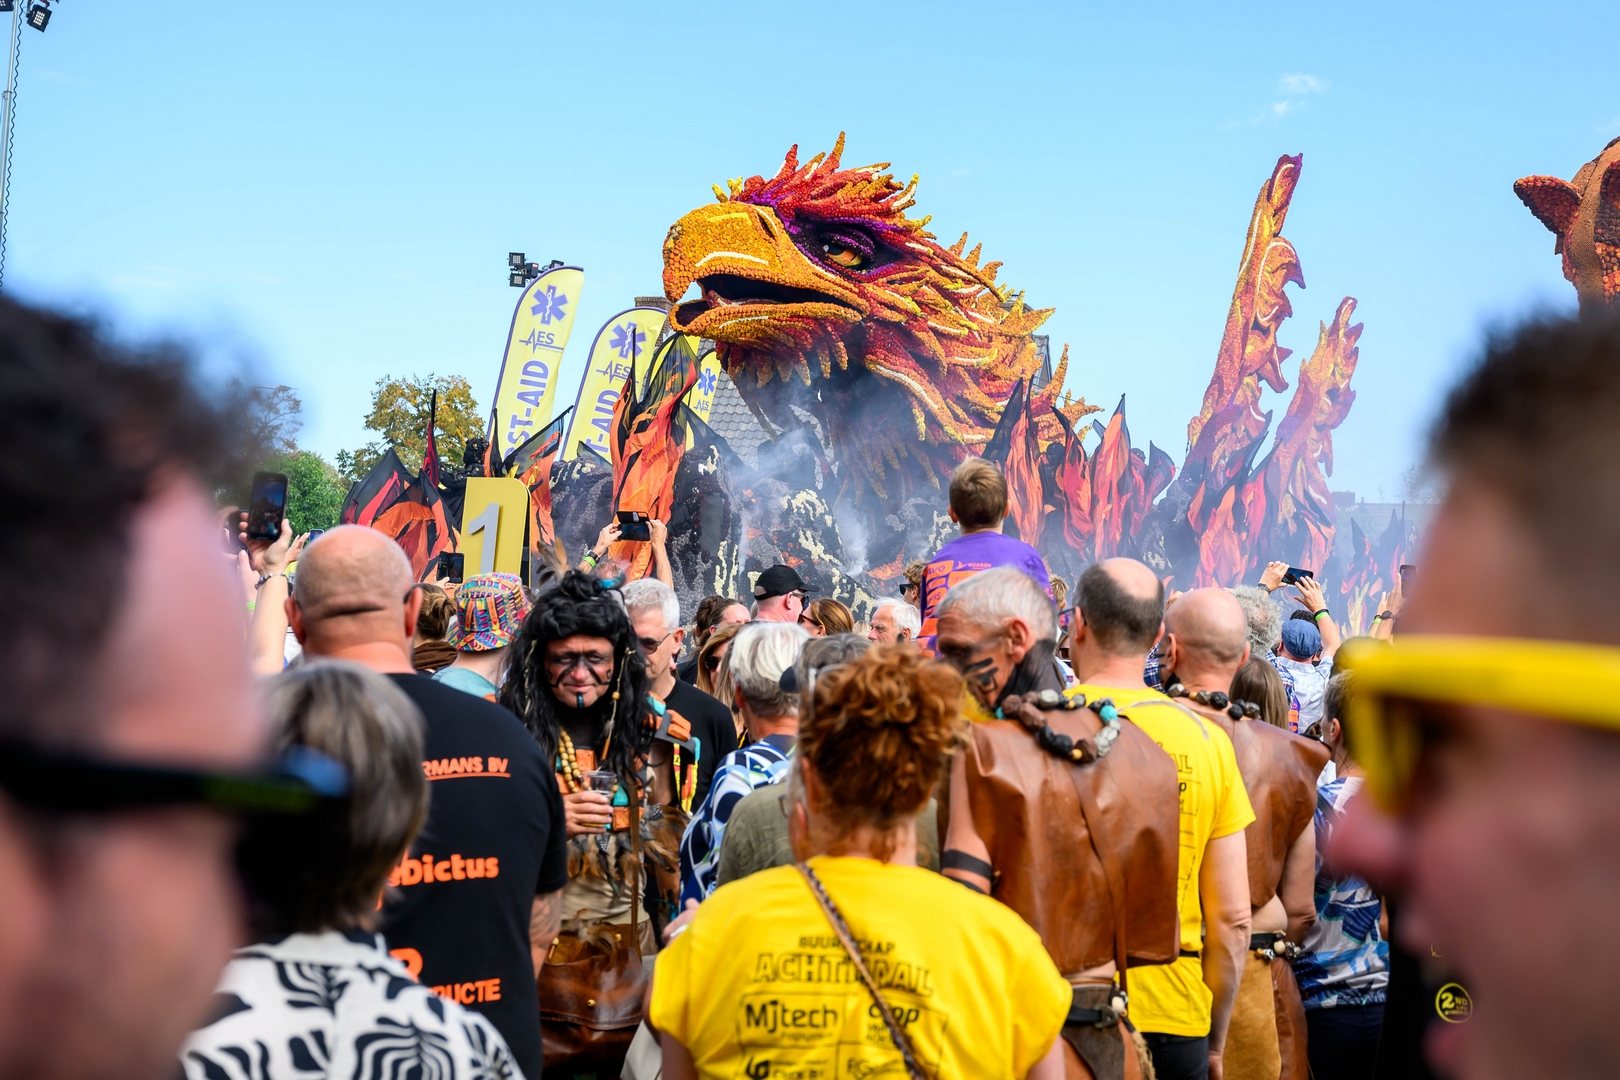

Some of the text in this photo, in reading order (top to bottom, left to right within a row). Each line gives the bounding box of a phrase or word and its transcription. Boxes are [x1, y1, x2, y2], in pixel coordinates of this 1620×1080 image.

[524, 327, 556, 354] AES
[468, 503, 500, 575] 1
[488, 757, 508, 773] BV
[746, 1000, 838, 1034] Mjtech
